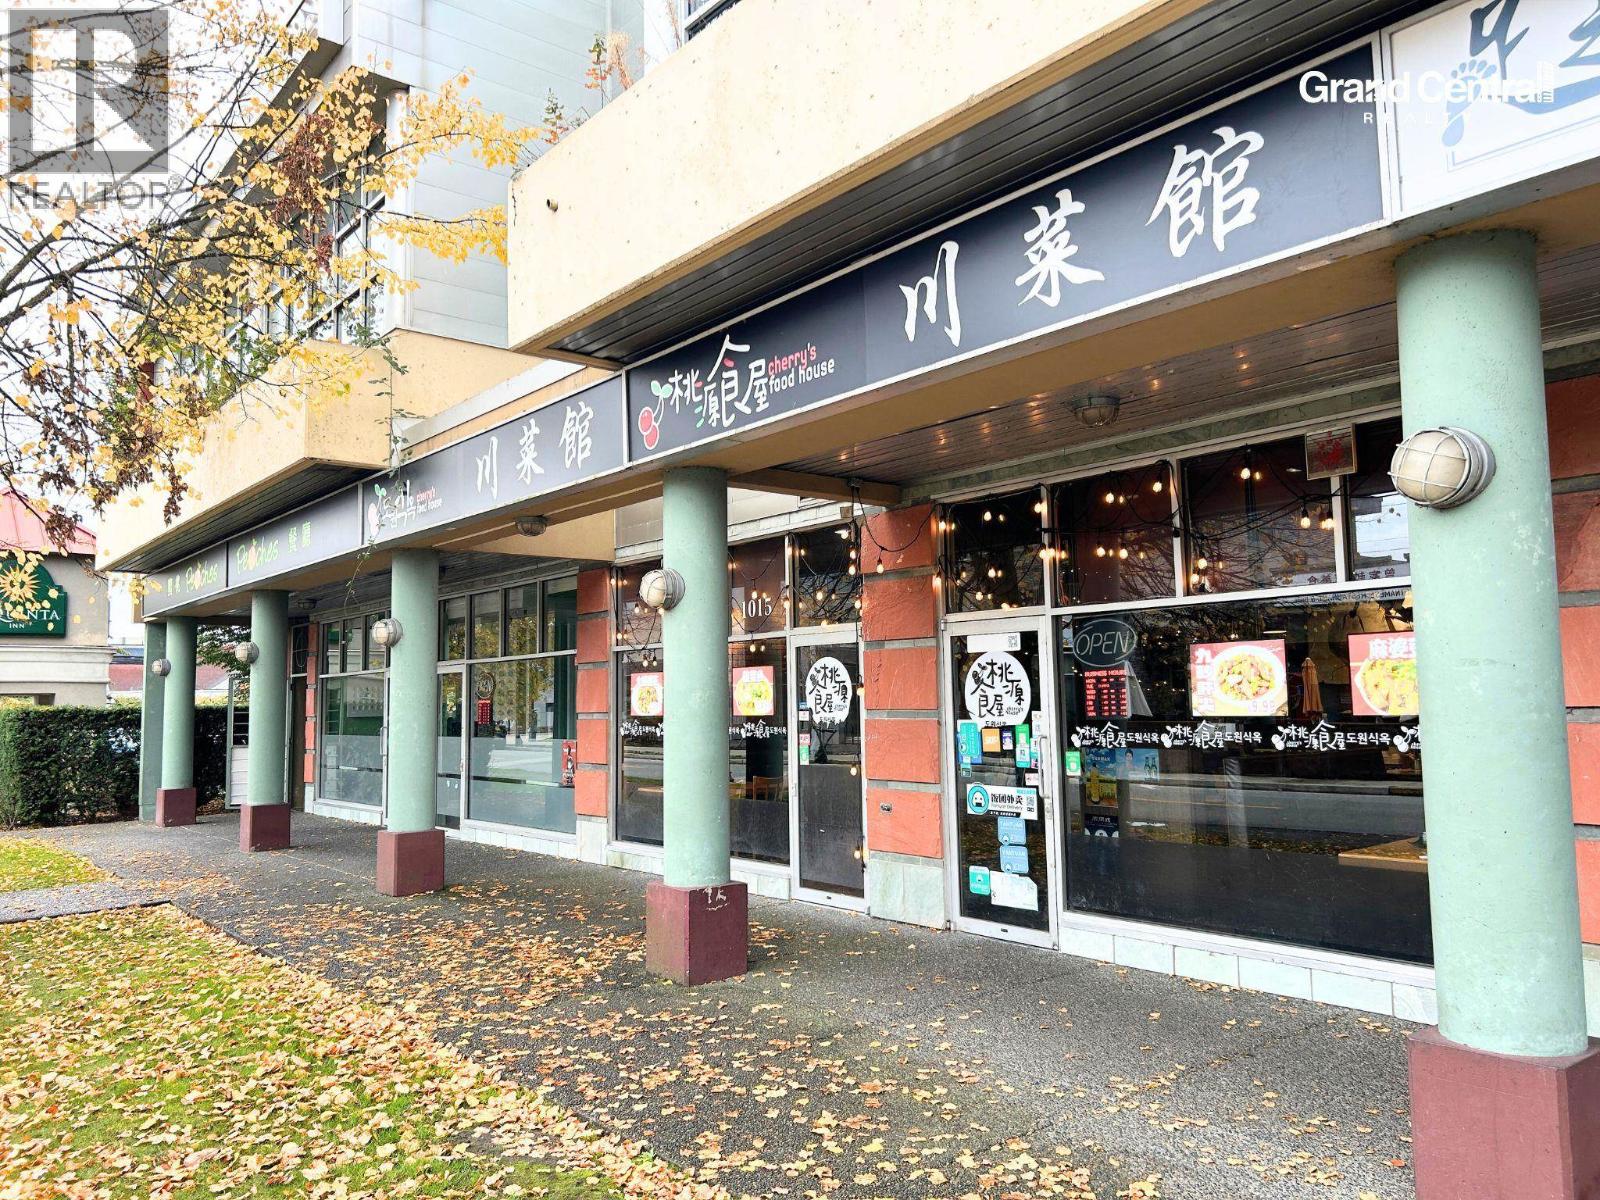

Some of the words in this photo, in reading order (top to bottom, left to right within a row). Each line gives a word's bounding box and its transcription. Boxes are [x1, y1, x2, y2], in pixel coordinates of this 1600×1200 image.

[899, 126, 1264, 347] 川菜館
[768, 343, 817, 376] cherry's
[769, 371, 795, 394] food
[799, 358, 835, 384] house
[475, 401, 594, 500] 川菜館
[741, 597, 773, 620] 1015
[1076, 631, 1131, 656] OPEN
[1224, 731, 1263, 744] 도원식옥
[1345, 731, 1391, 745] 도원식옥
